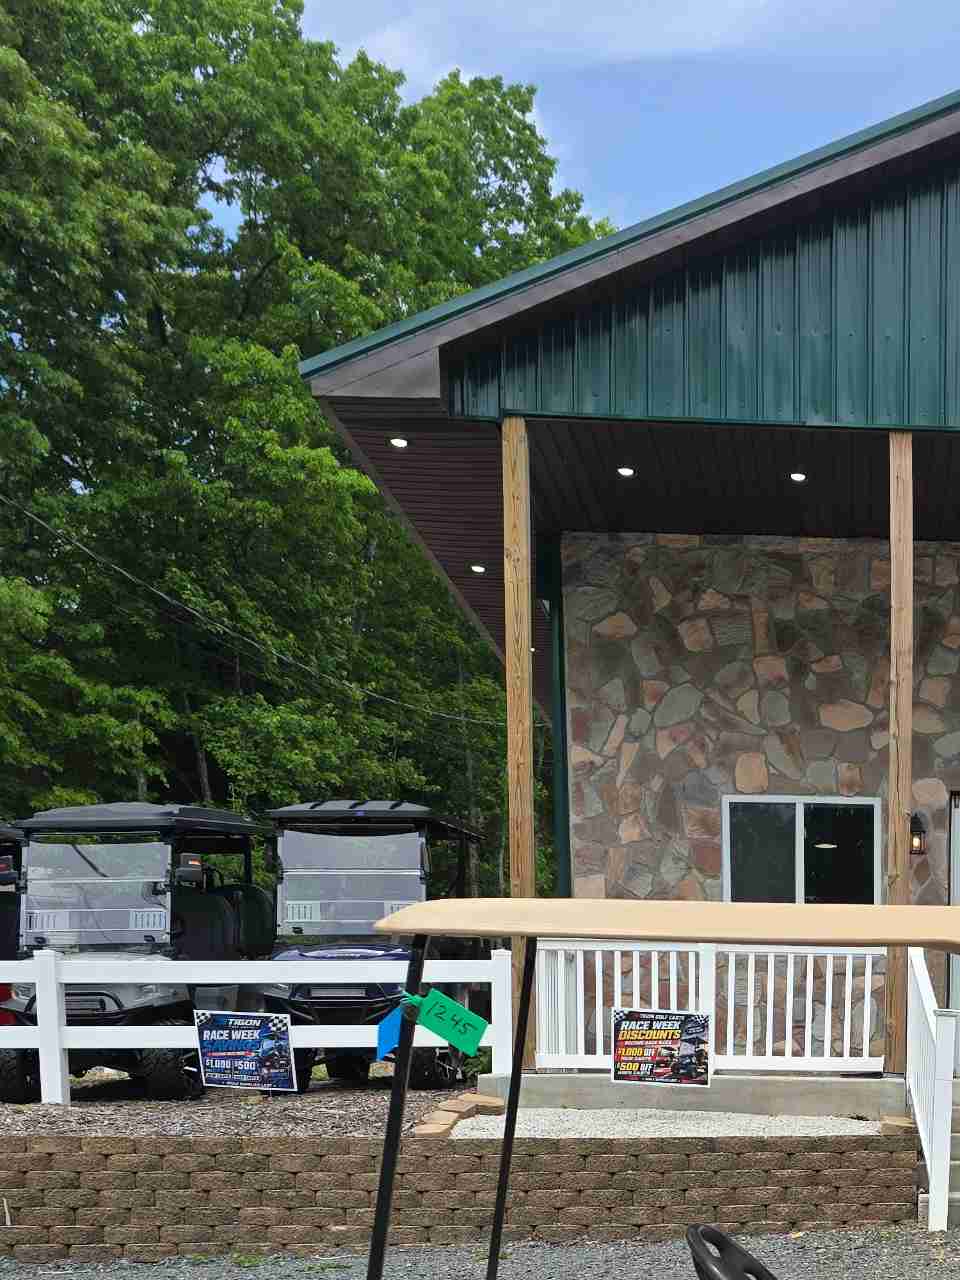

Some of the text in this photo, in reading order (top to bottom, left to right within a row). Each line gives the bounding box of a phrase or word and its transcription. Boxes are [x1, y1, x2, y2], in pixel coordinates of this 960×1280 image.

[425, 1001, 479, 1035] 1245
[620, 1020, 682, 1030] RACE WEEK
[203, 1030, 261, 1041] RACE WEEK
[618, 1030, 682, 1040] DISCOUNTS
